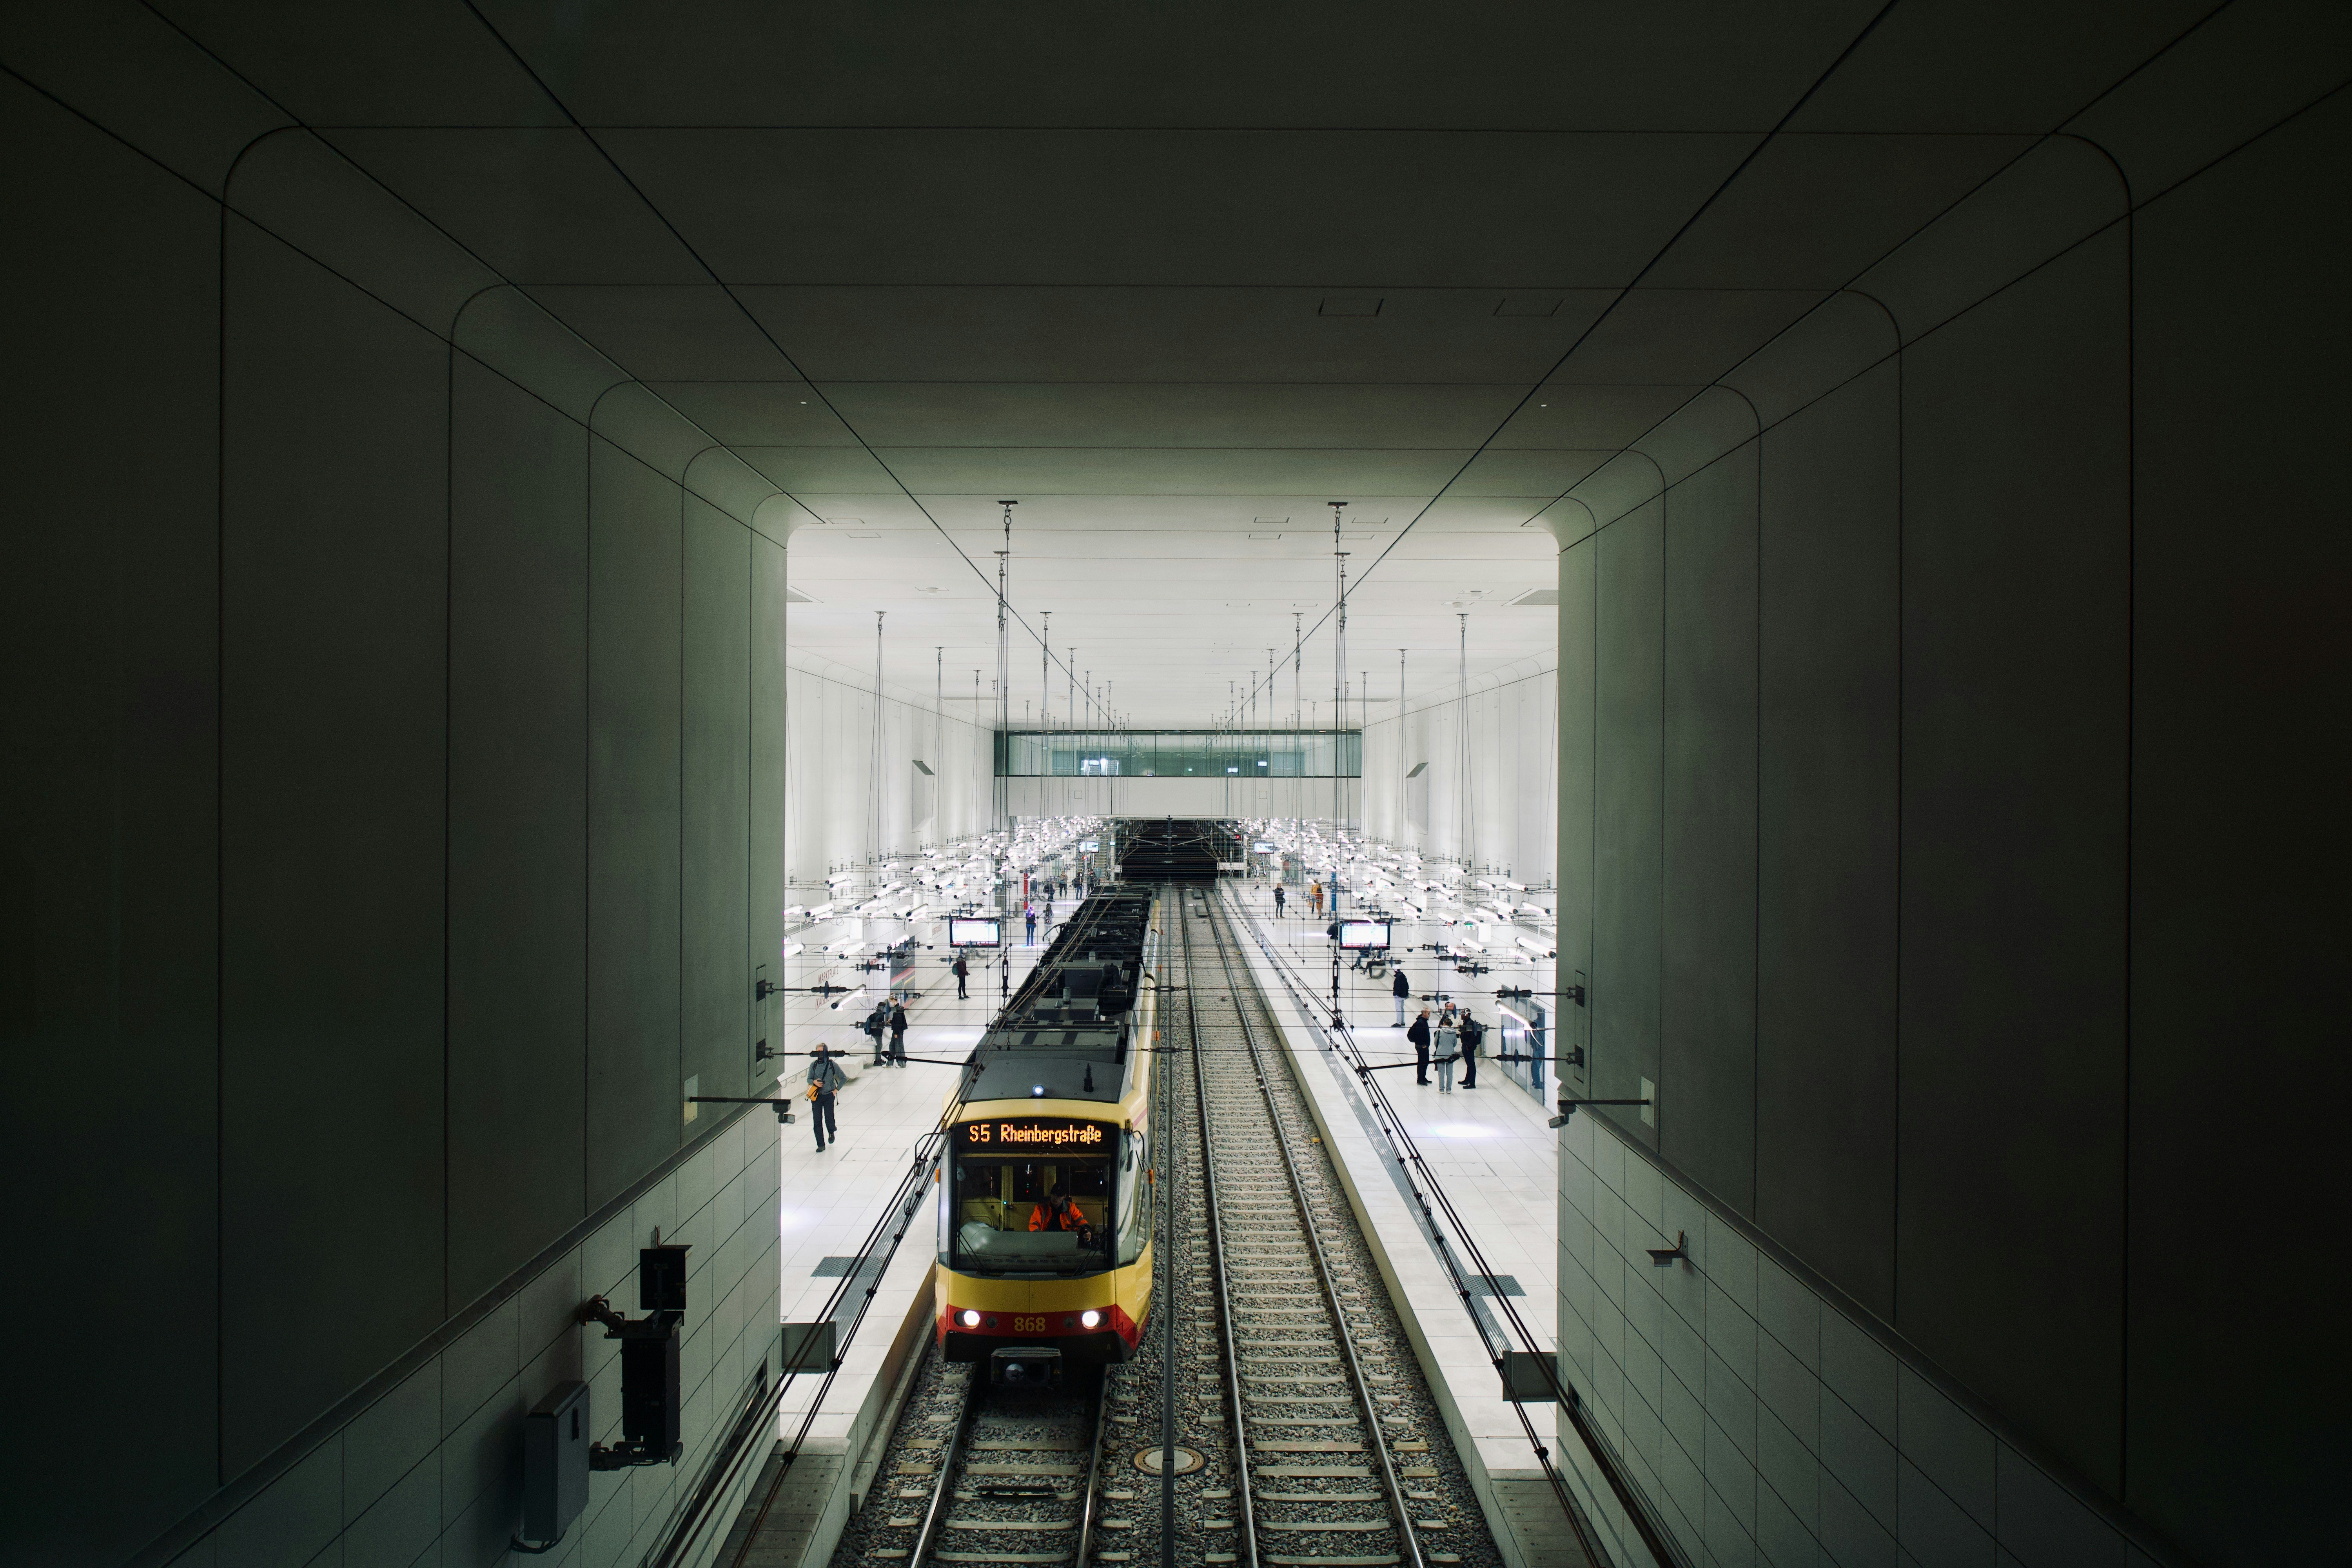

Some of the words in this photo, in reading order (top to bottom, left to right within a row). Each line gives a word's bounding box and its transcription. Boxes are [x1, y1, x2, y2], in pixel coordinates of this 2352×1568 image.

[818, 965, 839, 985] MARKTPLATZ
[969, 1124, 990, 1142] S5
[1000, 1123, 1102, 1145] Rheinbergstraße
[1014, 1317, 1046, 1332] 868
